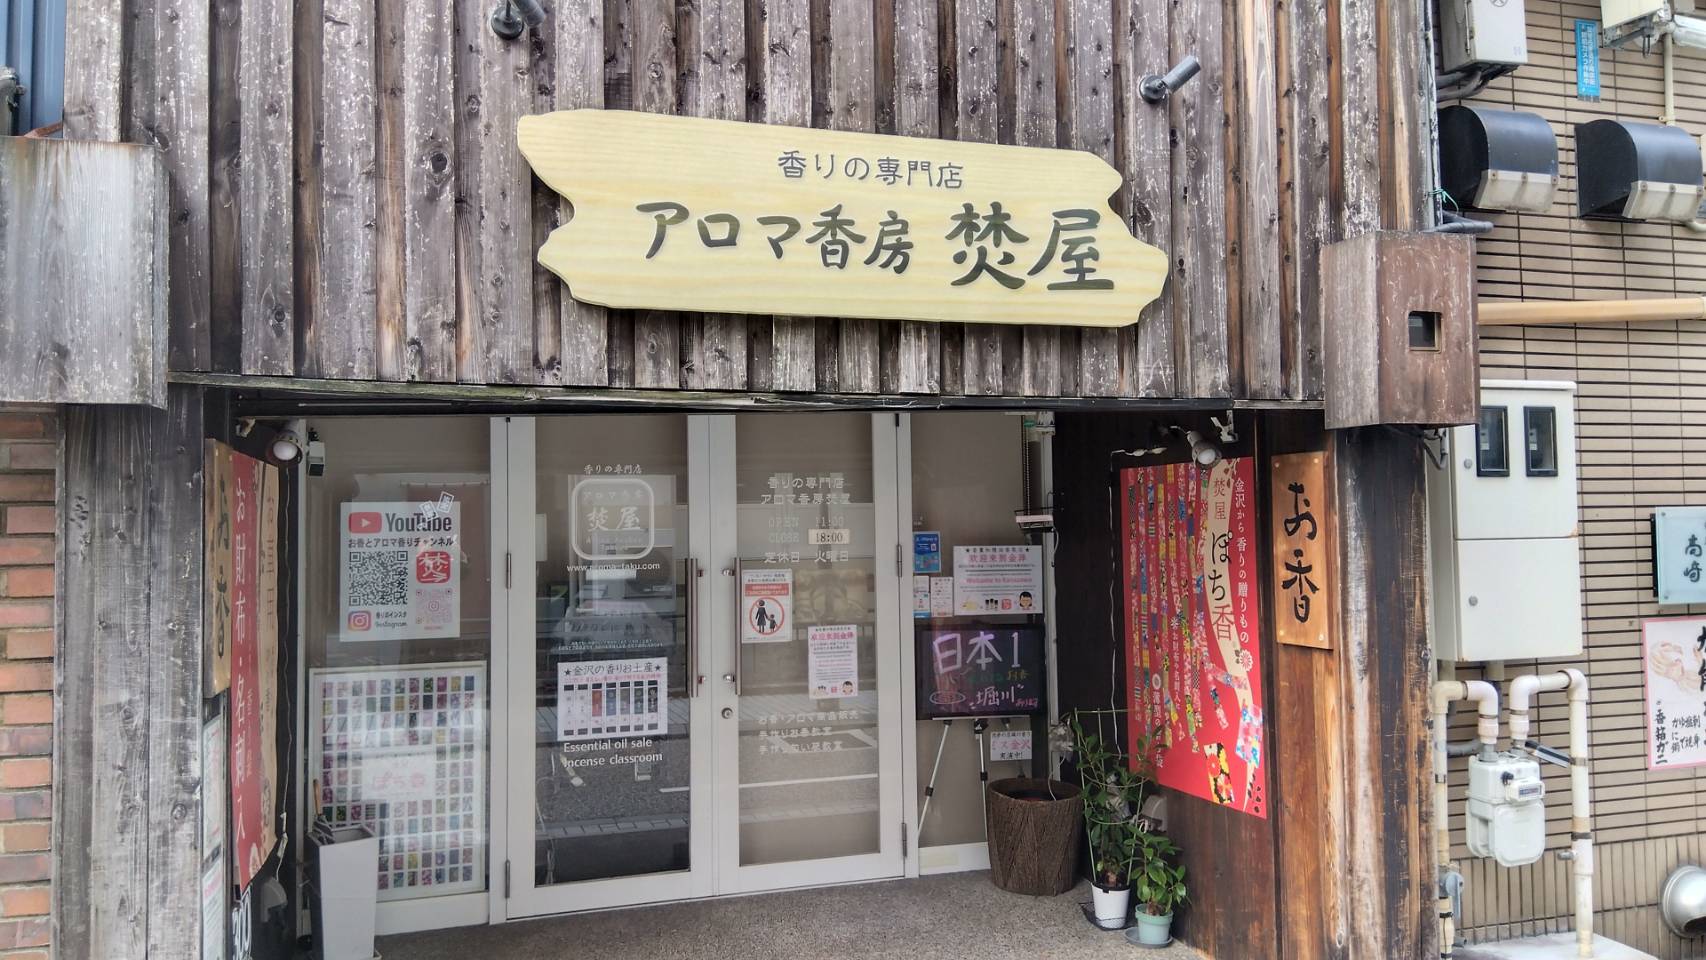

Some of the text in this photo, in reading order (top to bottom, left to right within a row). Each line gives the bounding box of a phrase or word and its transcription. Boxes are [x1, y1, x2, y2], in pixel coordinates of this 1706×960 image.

[777, 148, 965, 190] 香りの専門店
[635, 200, 1114, 292] アロマ香房 焚屋
[584, 464, 642, 474] 香りの専門店
[767, 476, 845, 489] 香りの専門店
[1212, 478, 1227, 520] 焚屋
[385, 512, 452, 532] YouTube
[586, 506, 641, 532] 焚屋
[815, 532, 843, 543] 18:00
[216, 473, 231, 658] お香
[764, 550, 849, 564] 定休日 火曜日
[1234, 479, 1250, 644] 金沢から香りの贈りもの
[1281, 481, 1320, 624] お香
[1208, 531, 1235, 642] ぽち香
[563, 737, 652, 753] Essential oil sale
[609, 751, 663, 765] classroom
